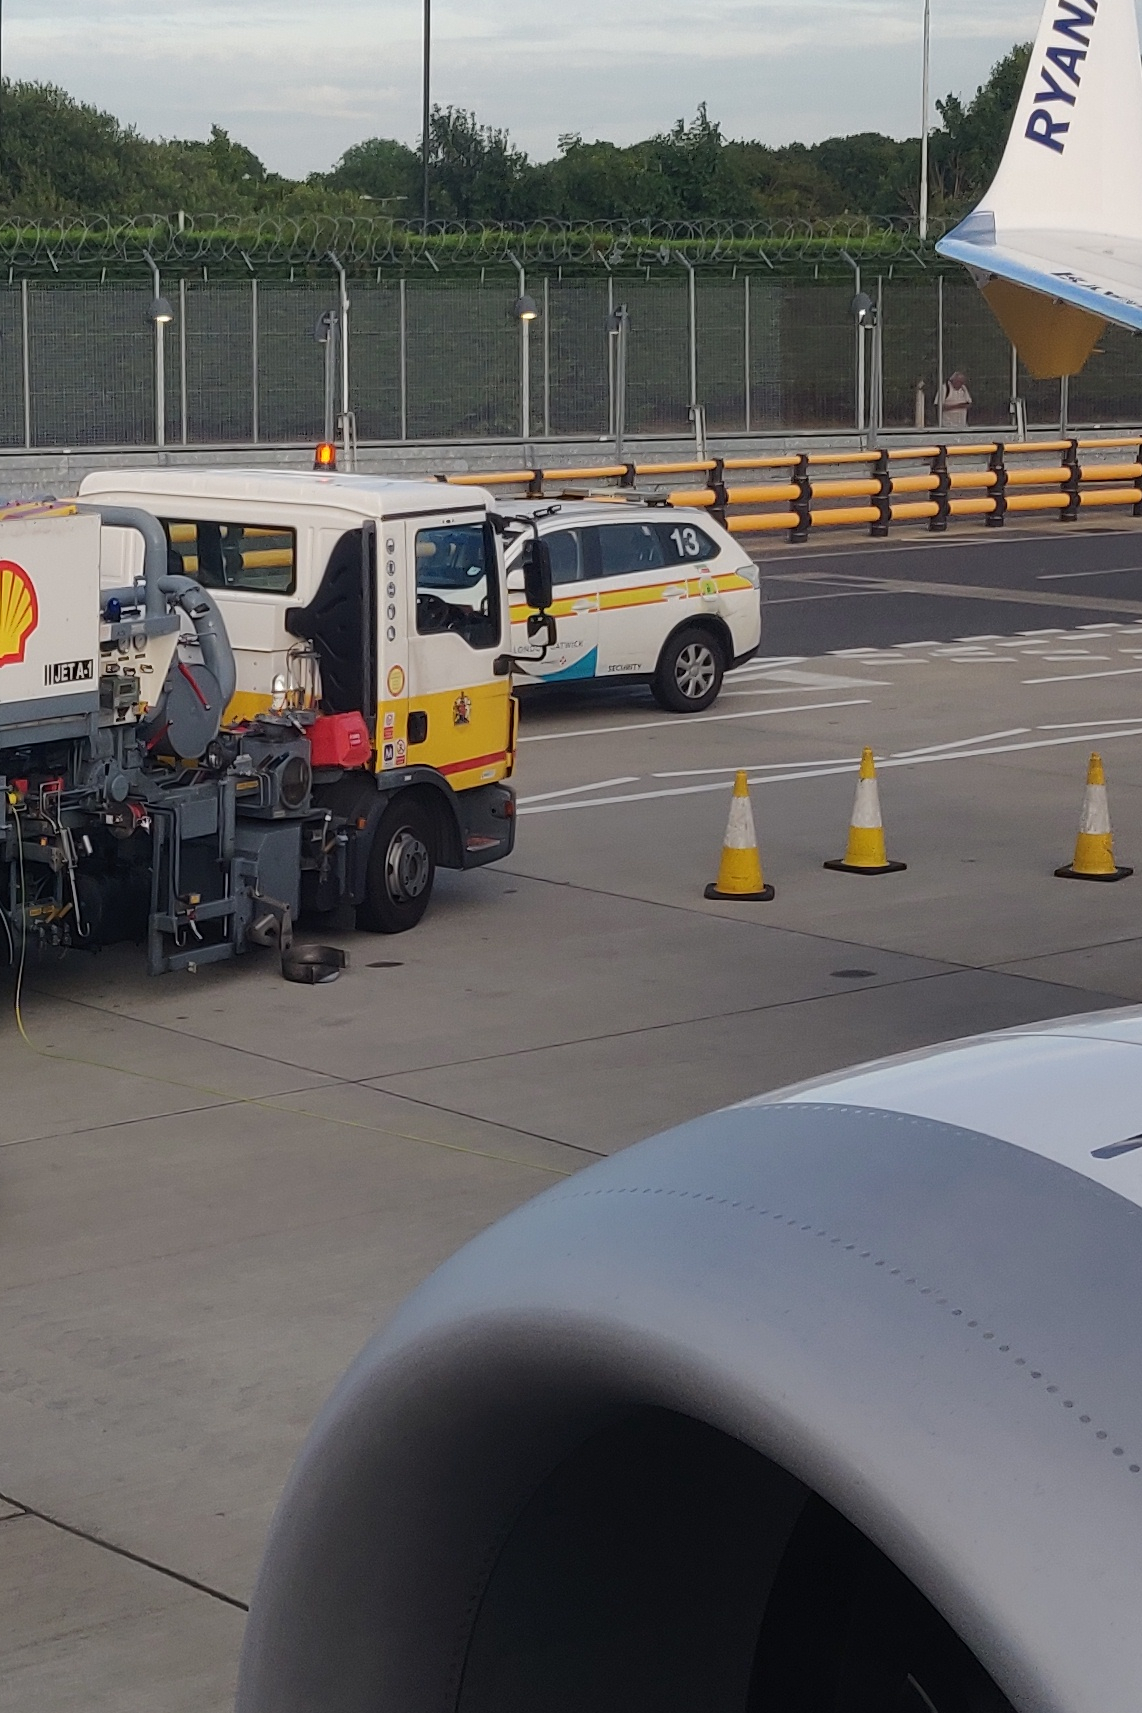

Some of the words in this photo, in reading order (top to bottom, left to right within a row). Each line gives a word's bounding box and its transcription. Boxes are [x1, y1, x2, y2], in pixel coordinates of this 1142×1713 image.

[1024, 0, 1098, 155] RYAN
[670, 527, 700, 557] 13
[54, 662, 76, 683] JET
[75, 660, 93, 680] A-1
[607, 664, 642, 673] SECURITY
